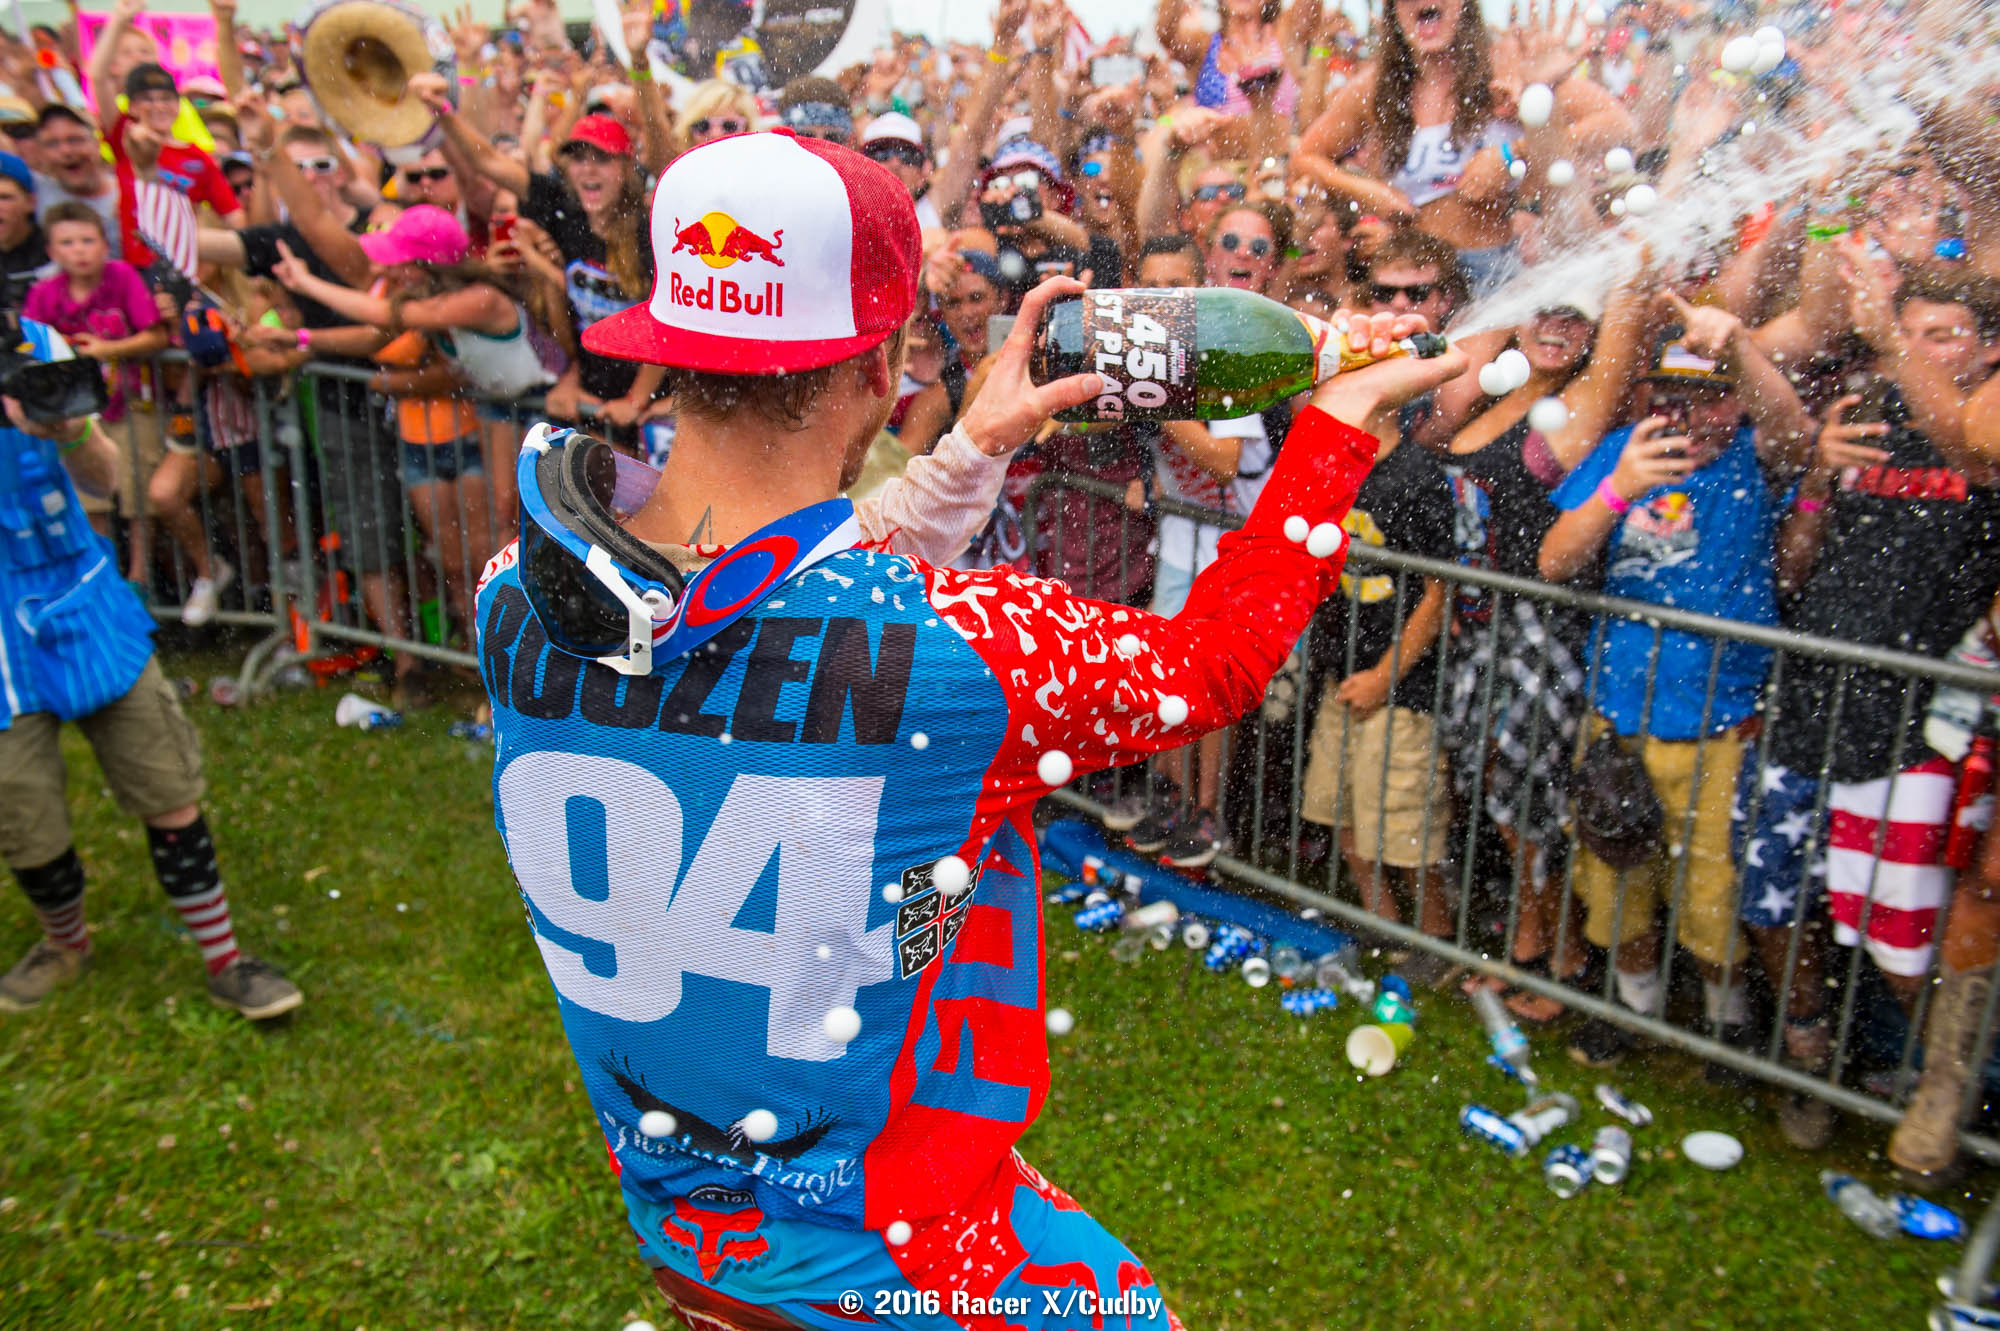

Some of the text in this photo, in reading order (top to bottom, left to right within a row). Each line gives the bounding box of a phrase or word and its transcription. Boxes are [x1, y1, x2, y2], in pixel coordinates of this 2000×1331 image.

[671, 271, 784, 318] Red Bull
[1126, 313, 1168, 409] 450
[499, 751, 893, 1061] 94
